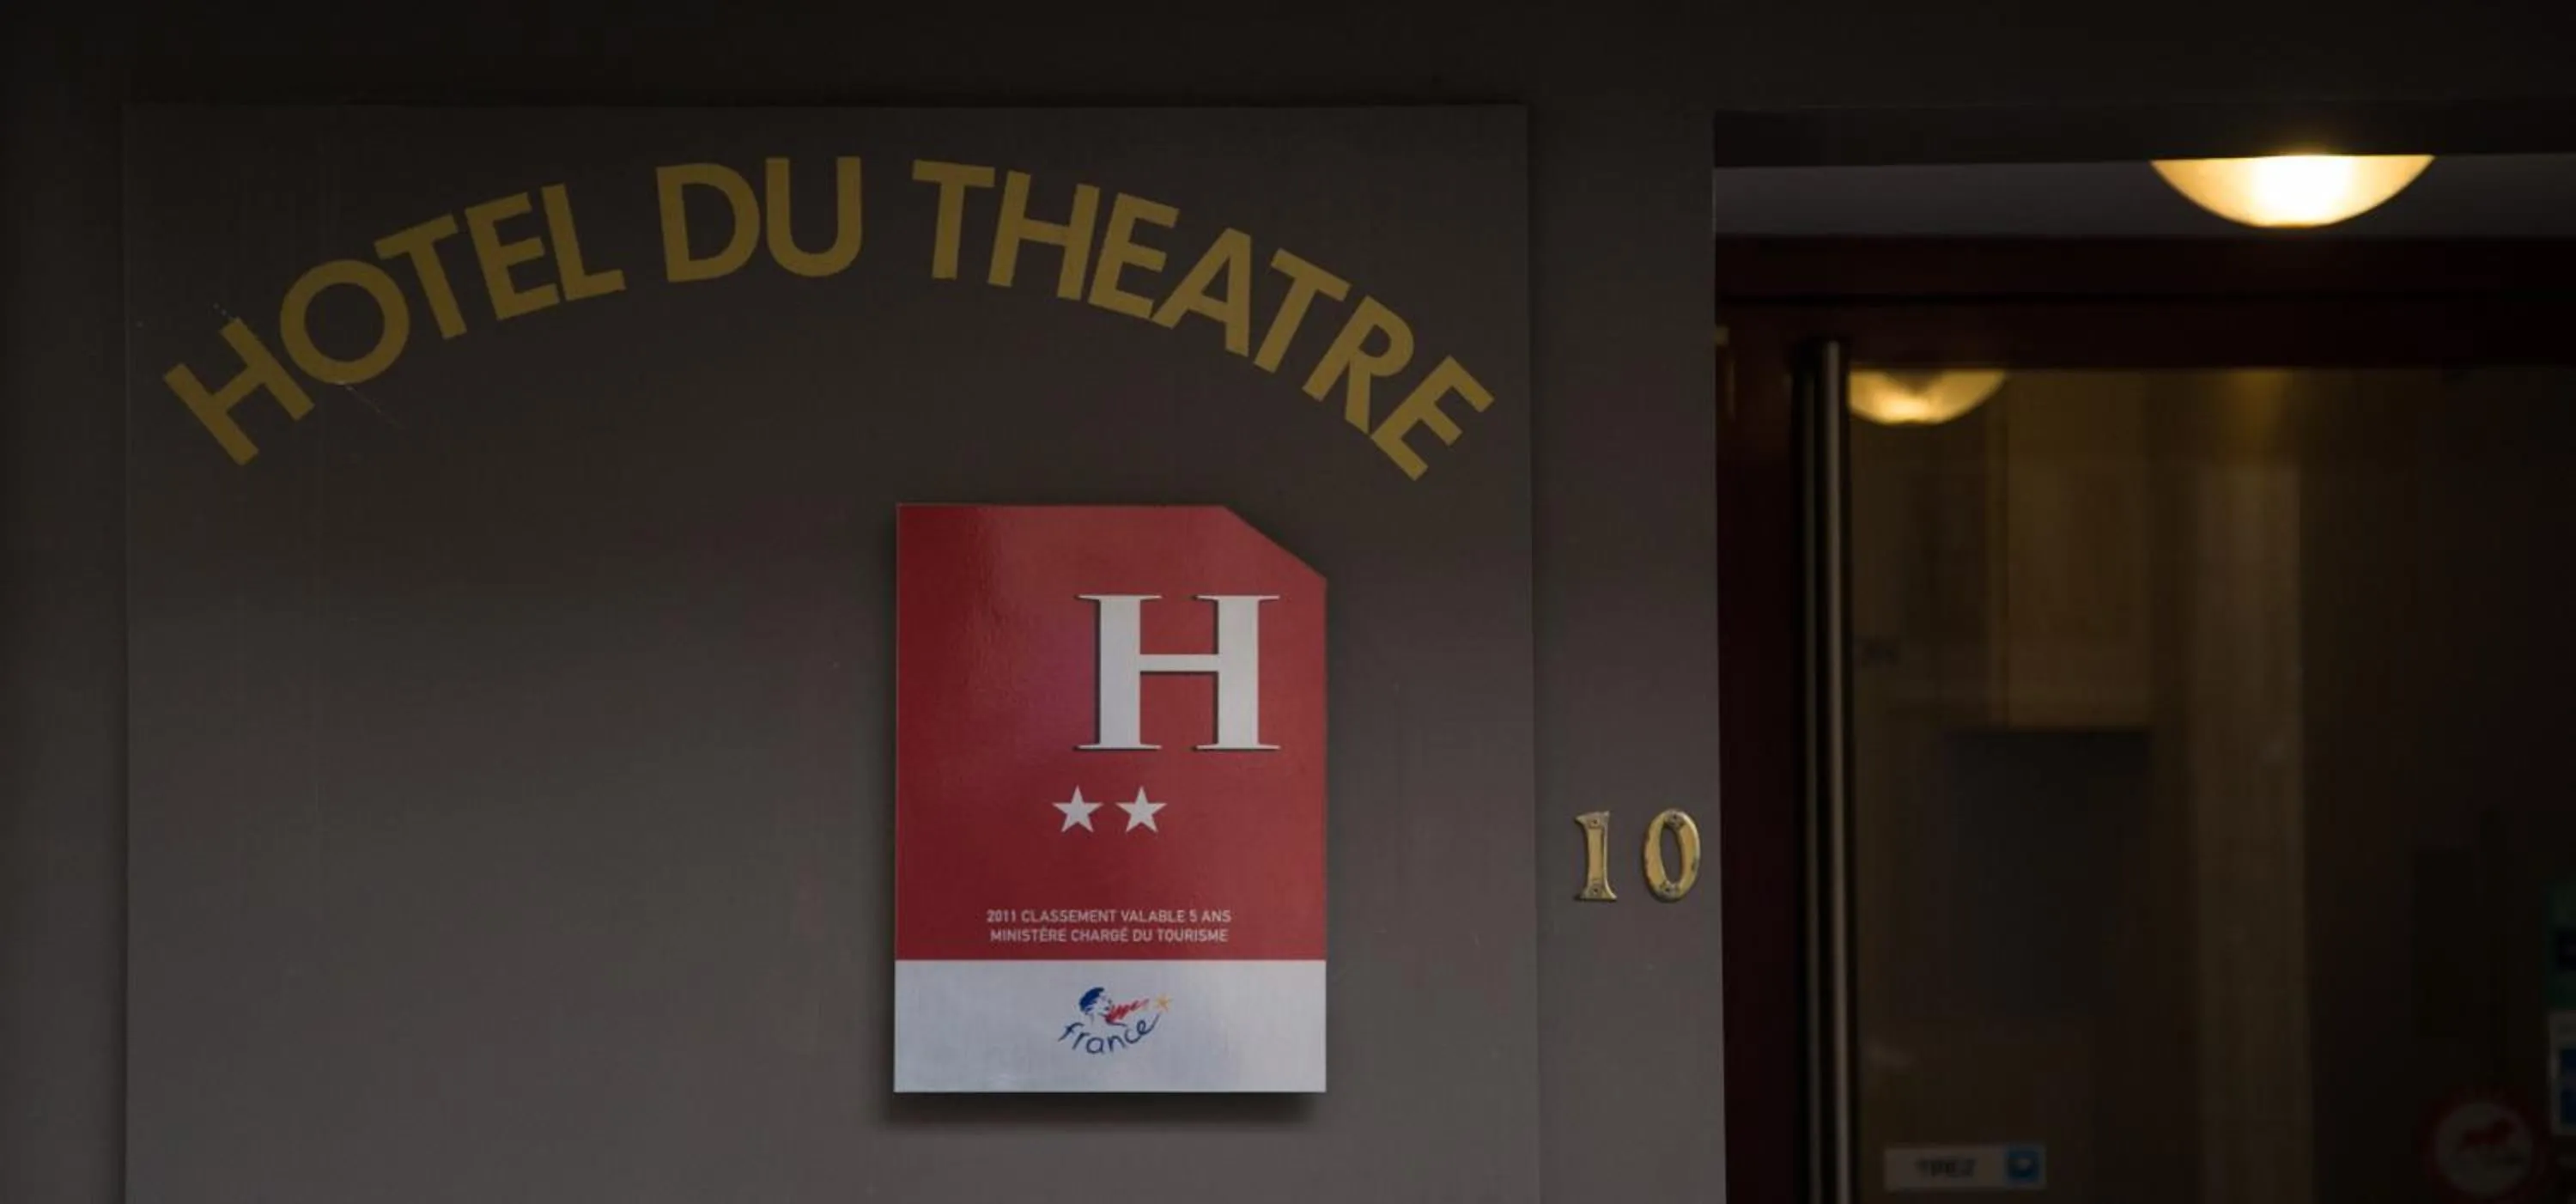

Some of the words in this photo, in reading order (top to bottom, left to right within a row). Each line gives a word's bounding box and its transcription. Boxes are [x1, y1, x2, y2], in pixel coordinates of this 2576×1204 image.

[165, 182, 627, 465] HOTEL
[656, 156, 866, 284] DU
[909, 158, 1496, 481] THEATRE
[1078, 594, 1279, 750] H
[1573, 808, 1700, 903] 10
[986, 909, 1017, 923] 2011
[1021, 909, 1116, 923] CLASSEMENT
[1121, 909, 1185, 923] VALABLE
[1188, 909, 1197, 923] 5
[1201, 909, 1231, 923] ANS
[1071, 926, 1127, 942] CHARGÉ
[1133, 928, 1152, 942] DU
[1157, 928, 1229, 943] TOURISME
[1058, 1012, 1161, 1054] france
